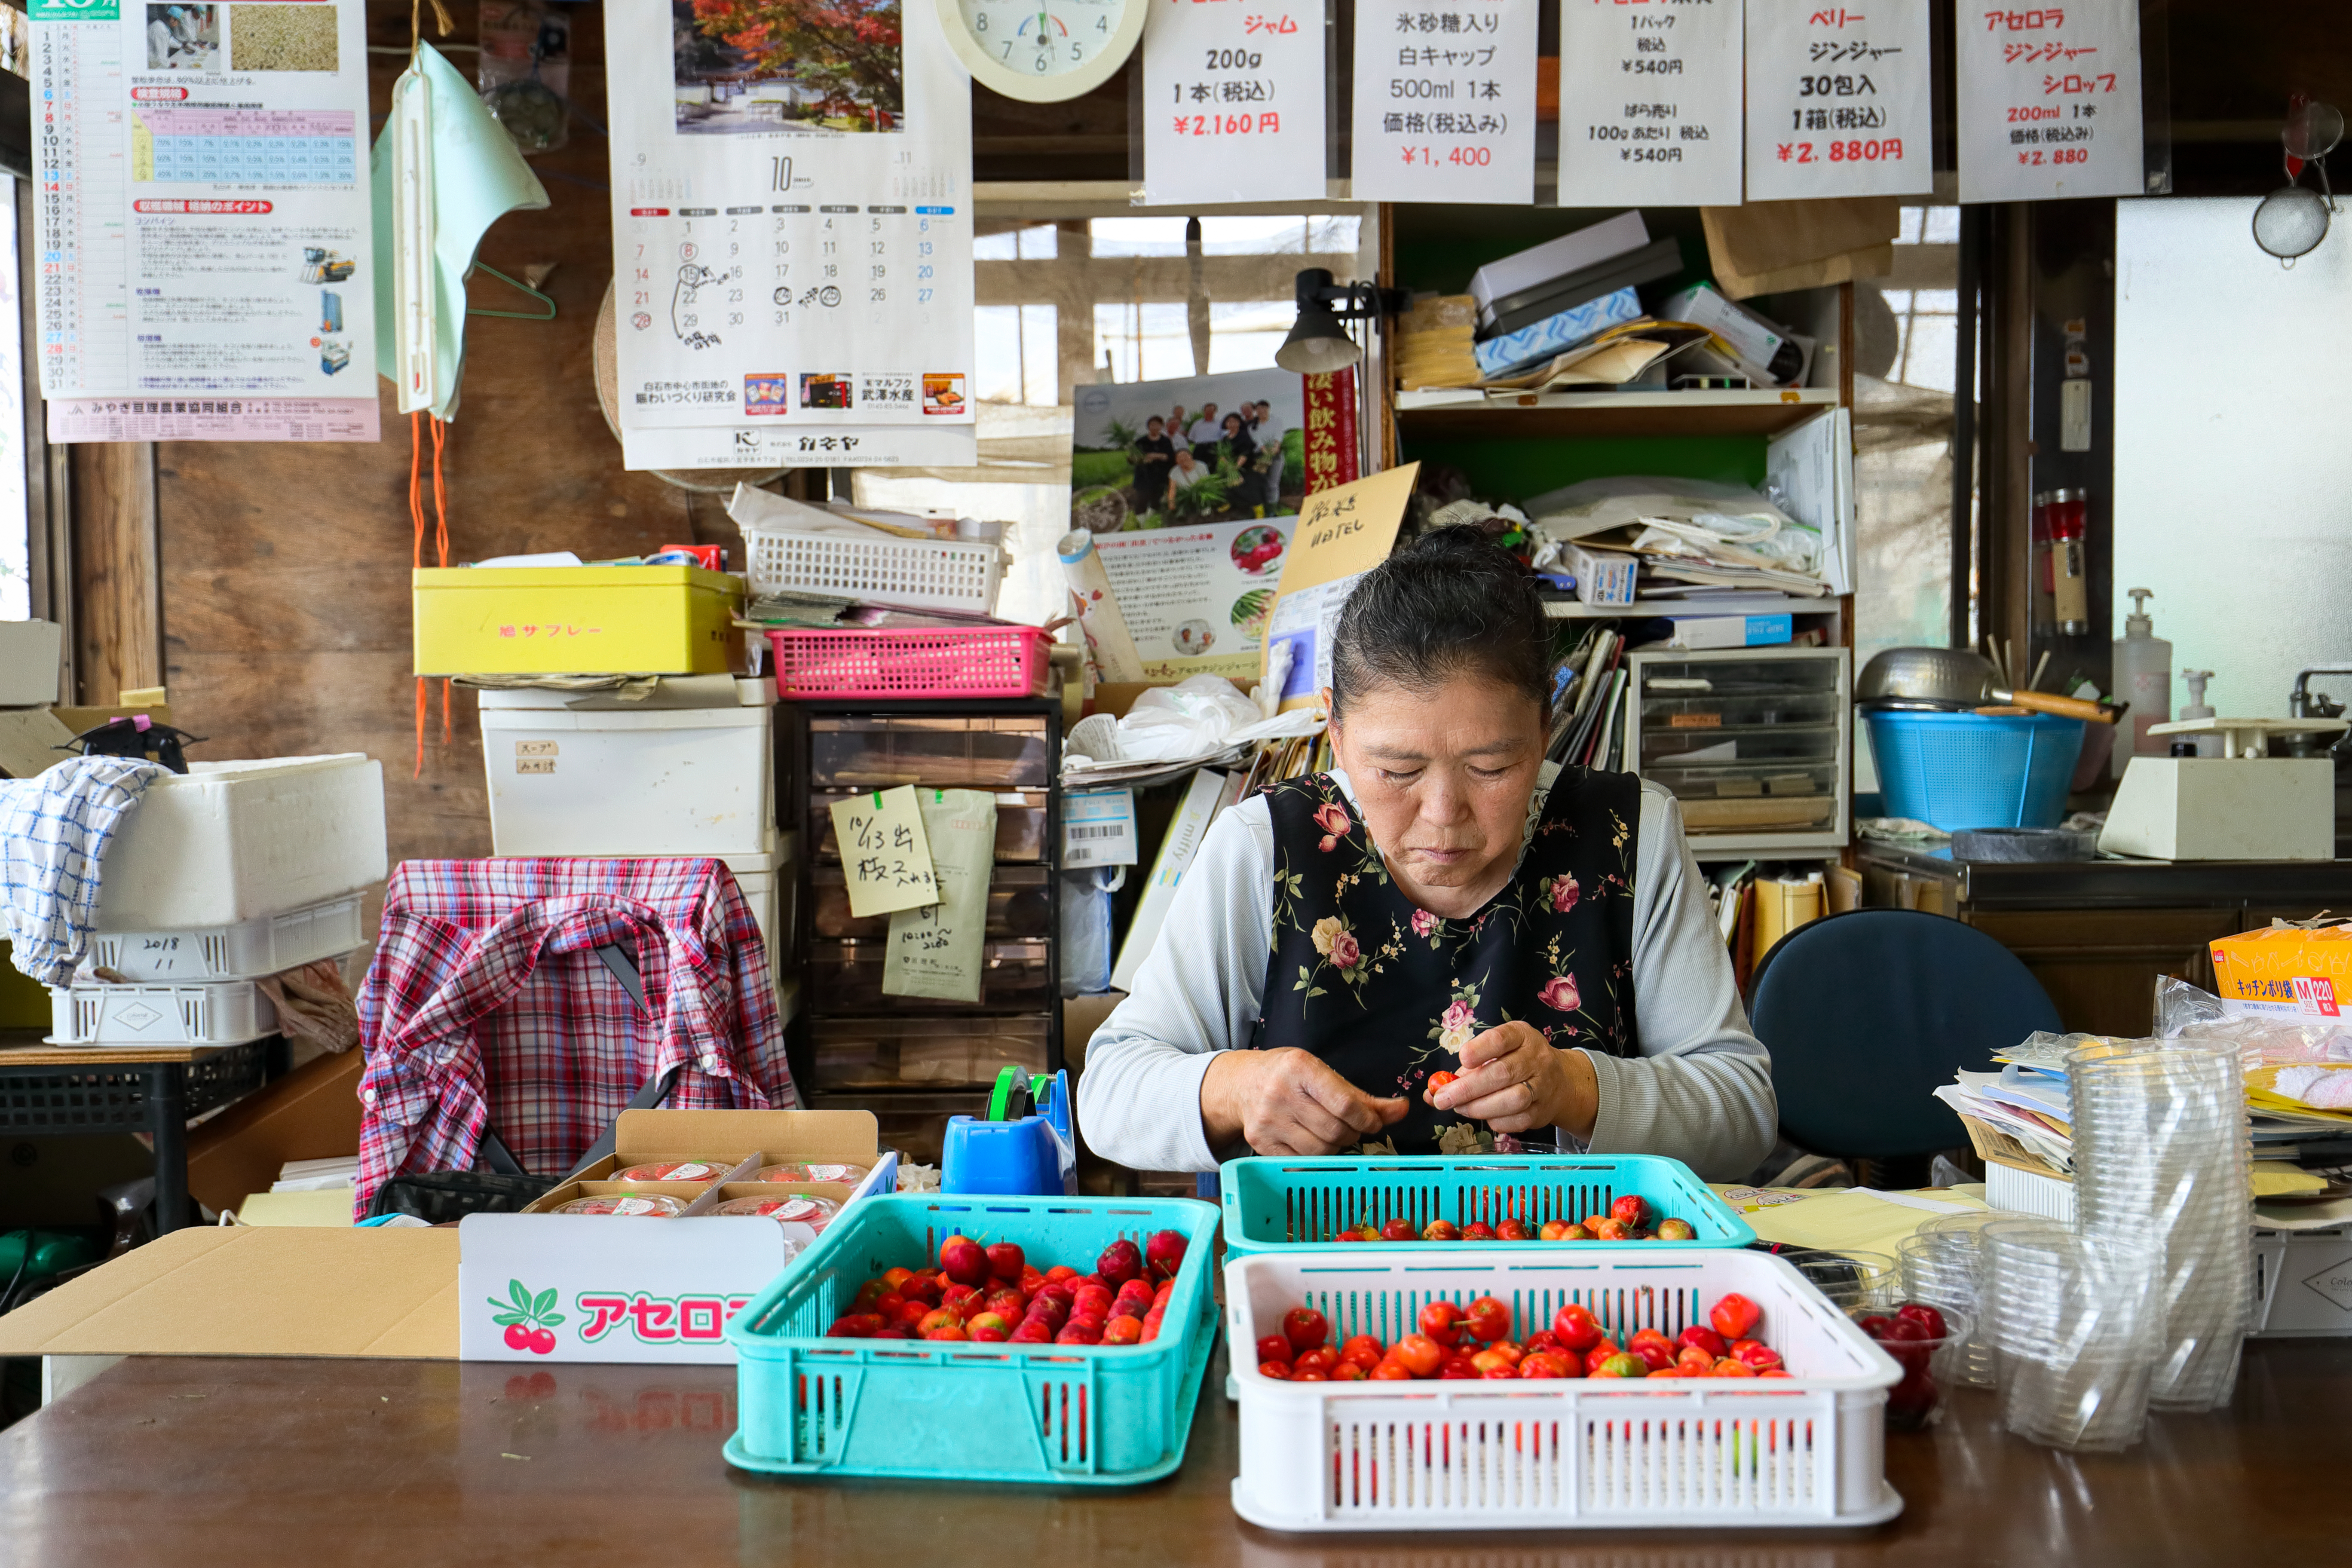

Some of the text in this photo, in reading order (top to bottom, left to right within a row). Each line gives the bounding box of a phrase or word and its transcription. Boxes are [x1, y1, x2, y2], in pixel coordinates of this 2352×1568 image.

[976, 12, 989, 32] 8
[1096, 14, 1109, 33] 4
[1244, 15, 1298, 34] ジャム
[1396, 13, 1499, 33] 氷砂糖入り
[1631, 15, 1675, 30] 1パック
[1810, 8, 1865, 28] ベリー
[1984, 8, 2064, 31] アセロラ
[44, 31, 49, 40] 1
[43, 43, 51, 52] 2
[1001, 40, 1014, 59] 7
[1070, 42, 1082, 61] 5
[1637, 37, 1666, 52] 税込
[1810, 41, 1902, 62] ジンジャー
[43, 54, 52, 64] 3
[1207, 49, 1262, 70] 200g
[1399, 45, 1497, 66] 白キャップ
[2004, 42, 2097, 63] ジンジャー
[1035, 53, 1047, 72] 6
[1622, 59, 1683, 74] ¥540円
[43, 66, 52, 76] 4
[44, 78, 52, 87] 5
[1390, 79, 1501, 100] 500ml 1本
[1800, 74, 1877, 96] 30包入
[44, 89, 53, 99] 6
[45, 101, 52, 110] 7
[1625, 104, 1677, 118] ばら売り
[2007, 103, 2097, 122] 200ml 1本
[45, 113, 53, 122] 8
[1383, 113, 1507, 135] 価格(税込み)
[45, 124, 54, 134] 9
[1680, 125, 1709, 141] 税込
[2010, 125, 2094, 145] 価格(税込み)
[43, 136, 58, 145] 10
[43, 148, 57, 157] 11
[637, 152, 646, 166] 9
[900, 151, 912, 164] 11
[1620, 147, 1682, 162] ¥540円
[44, 159, 59, 168] 12
[44, 171, 59, 181] 13
[772, 156, 792, 192] 10
[45, 182, 59, 192] 14
[45, 194, 59, 204] 15
[45, 205, 60, 215] 16
[45, 217, 59, 227] 17
[686, 217, 929, 233] 1 2 3 4 5 6
[46, 229, 61, 238] 18
[46, 240, 61, 250] 19
[637, 241, 933, 257] 7 8 9 10 11 12 13
[44, 252, 61, 261] 20
[45, 263, 59, 273] 21
[636, 268, 649, 280] 14
[684, 267, 697, 280] 15
[730, 265, 743, 279] 16
[776, 263, 789, 277] 17
[824, 264, 838, 278] 18
[872, 265, 885, 278] 19
[919, 265, 933, 279] 20
[45, 275, 61, 285] 22
[45, 287, 61, 296] 23
[635, 288, 933, 305] 21 22 23 24 25 26 27
[45, 298, 61, 308] 24
[45, 310, 62, 319] 25
[635, 311, 790, 328] 28 29 30 31
[46, 322, 62, 331] 26
[45, 333, 61, 343] 27
[46, 345, 63, 354] 28
[47, 356, 63, 366] 29
[48, 368, 64, 377] 30
[49, 380, 63, 389] 31
[644, 380, 729, 392] 白石市中心市街地の
[636, 390, 736, 405] 賑わいづくり研究会
[862, 389, 915, 402] 武澤水産
[1172, 823, 1195, 862] miffy
[144, 937, 179, 951] 2018
[2237, 979, 2295, 999] キッチンポリ袋
[2296, 981, 2312, 1001] M
[2313, 981, 2333, 1001] 220
[2322, 1003, 2334, 1012] 枚入
